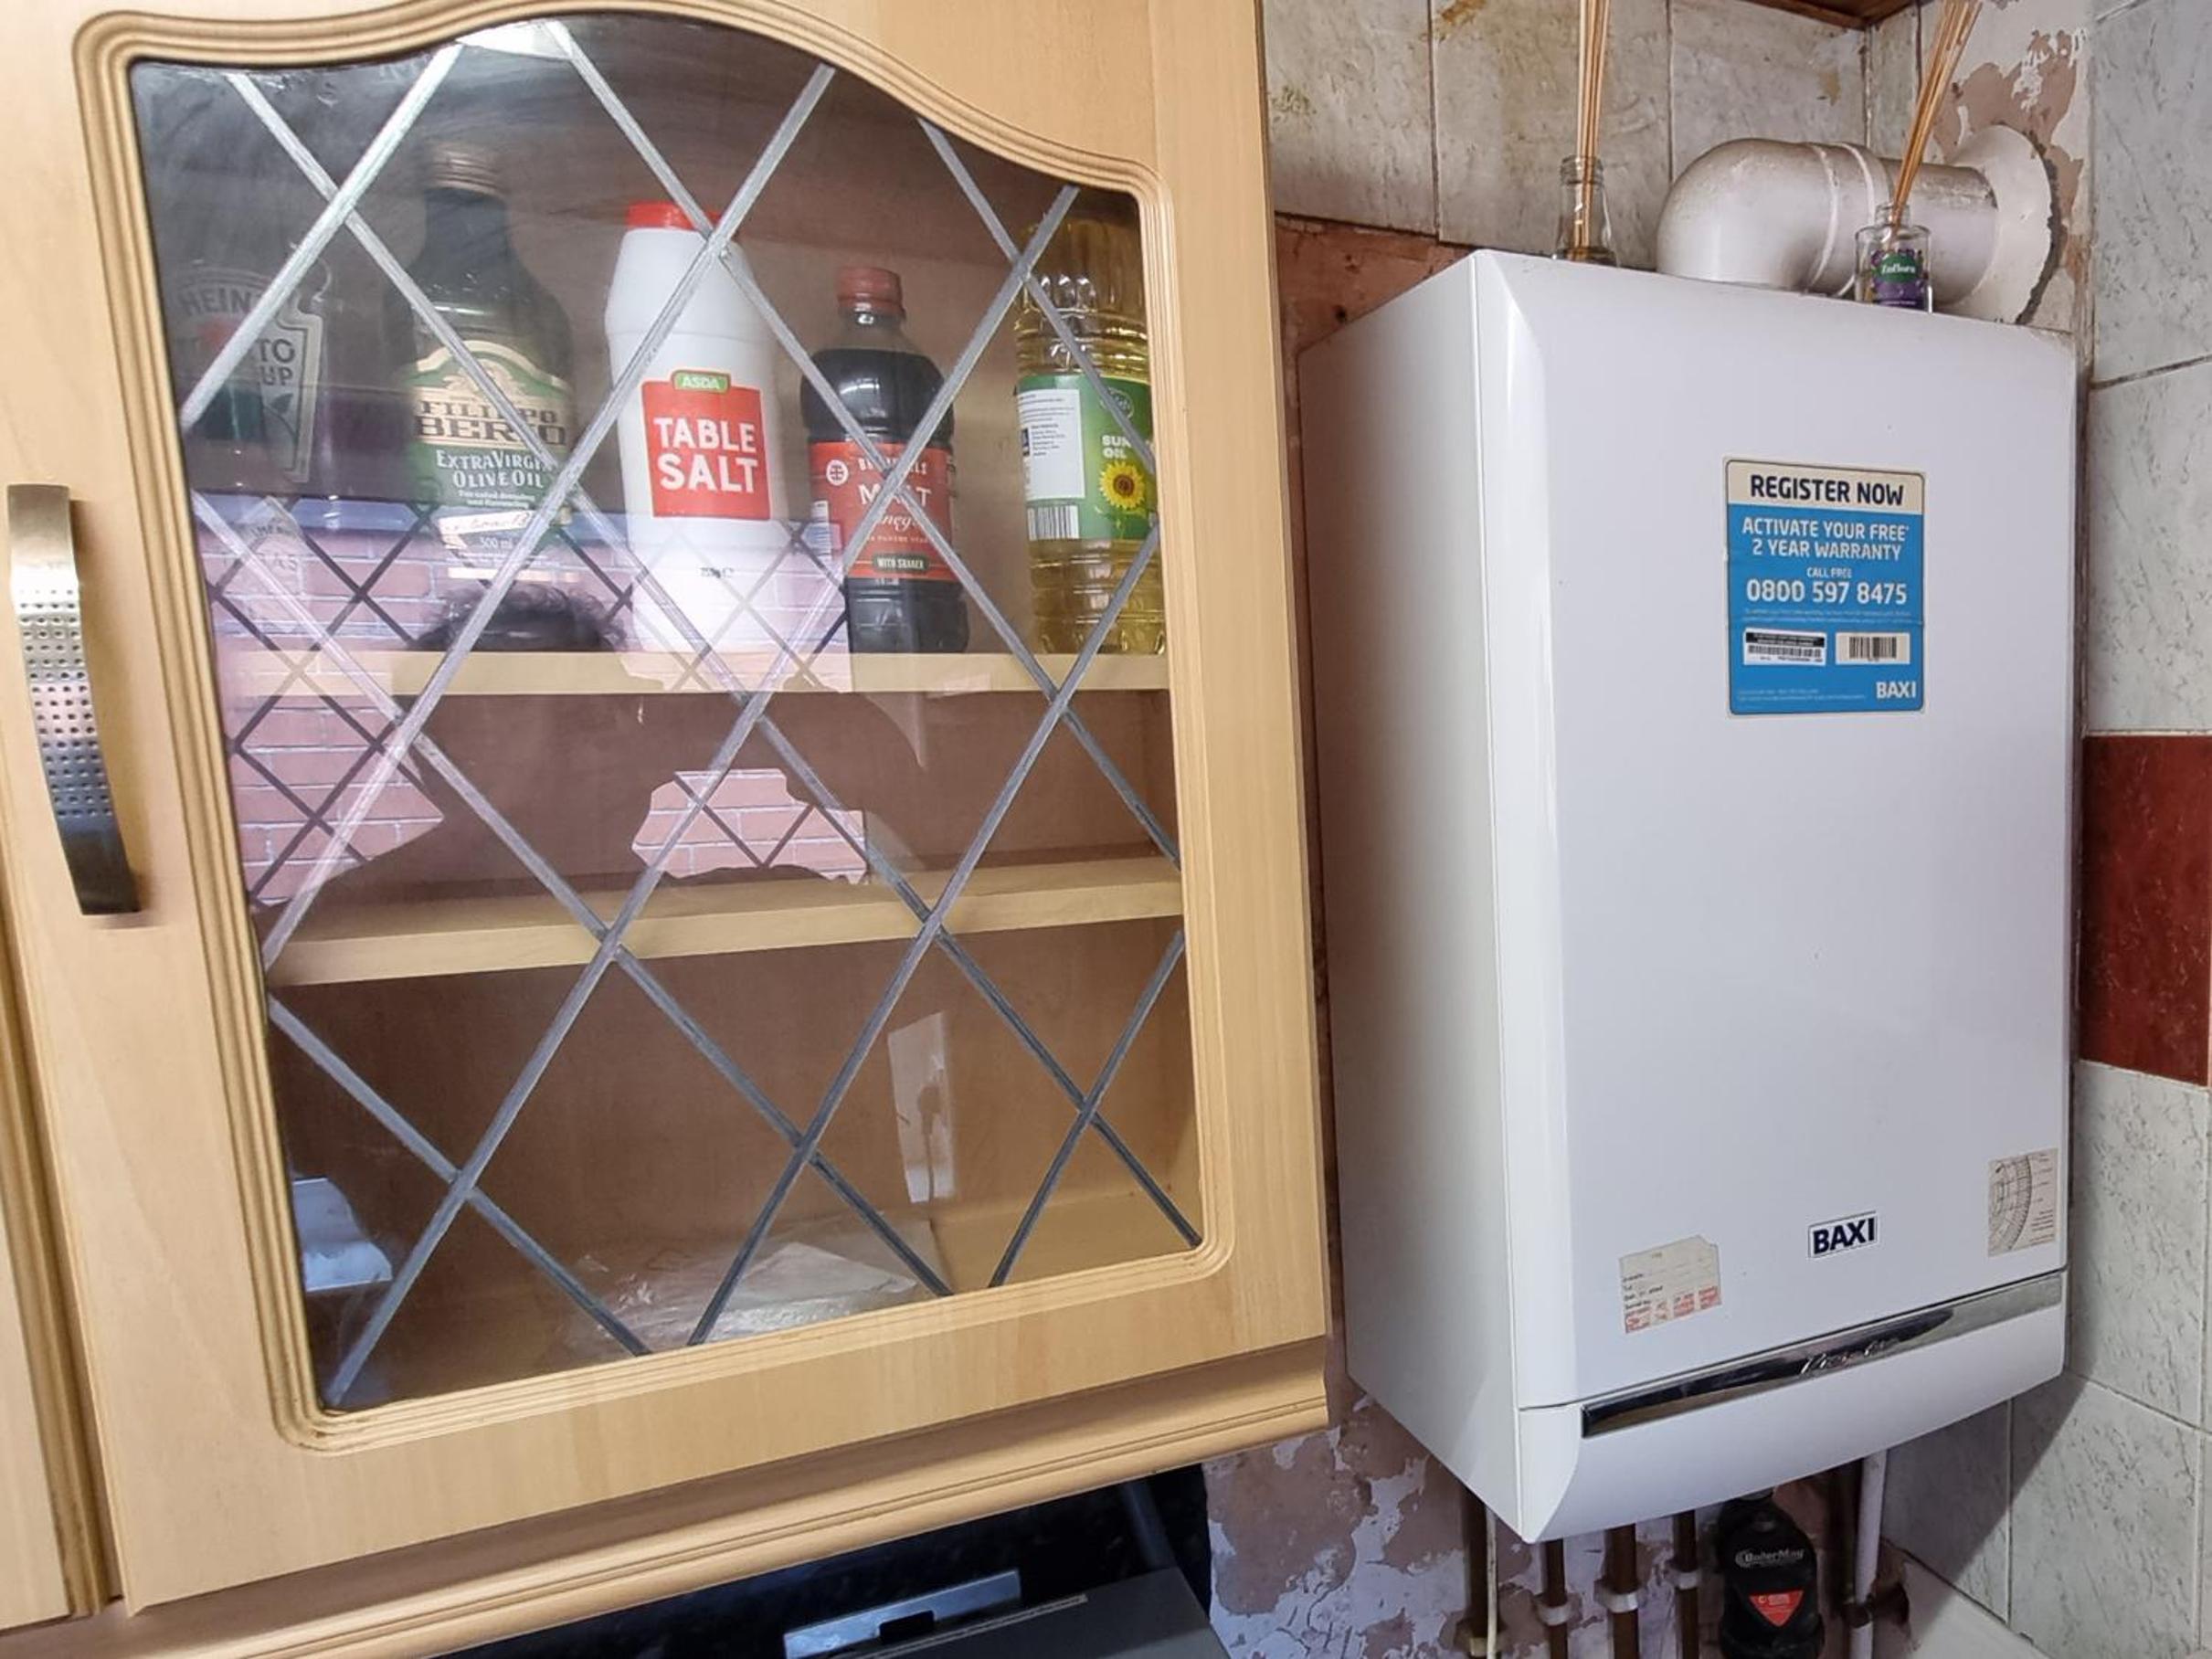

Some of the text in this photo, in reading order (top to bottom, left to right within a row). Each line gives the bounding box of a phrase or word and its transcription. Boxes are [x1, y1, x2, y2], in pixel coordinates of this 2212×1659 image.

[179, 288, 263, 317] HEIN
[681, 375, 720, 390] ASDA
[416, 416, 566, 446] BERO
[652, 417, 757, 454] TABLE
[492, 449, 552, 472] VIRGI
[657, 452, 759, 494] SALT
[512, 469, 545, 489] OIL
[1750, 473, 1904, 506] REGISTER NOW
[1741, 516, 1819, 537] ACTIVATE
[1823, 521, 1865, 540] YOUR
[1752, 538, 1901, 561] 2 YEAR WARRANTY
[1805, 566, 1828, 578] CALL
[1746, 578, 1907, 606] 0800 597 8475
[1876, 681, 1917, 700] BAXI
[1812, 1217, 1876, 1255] BAXI
